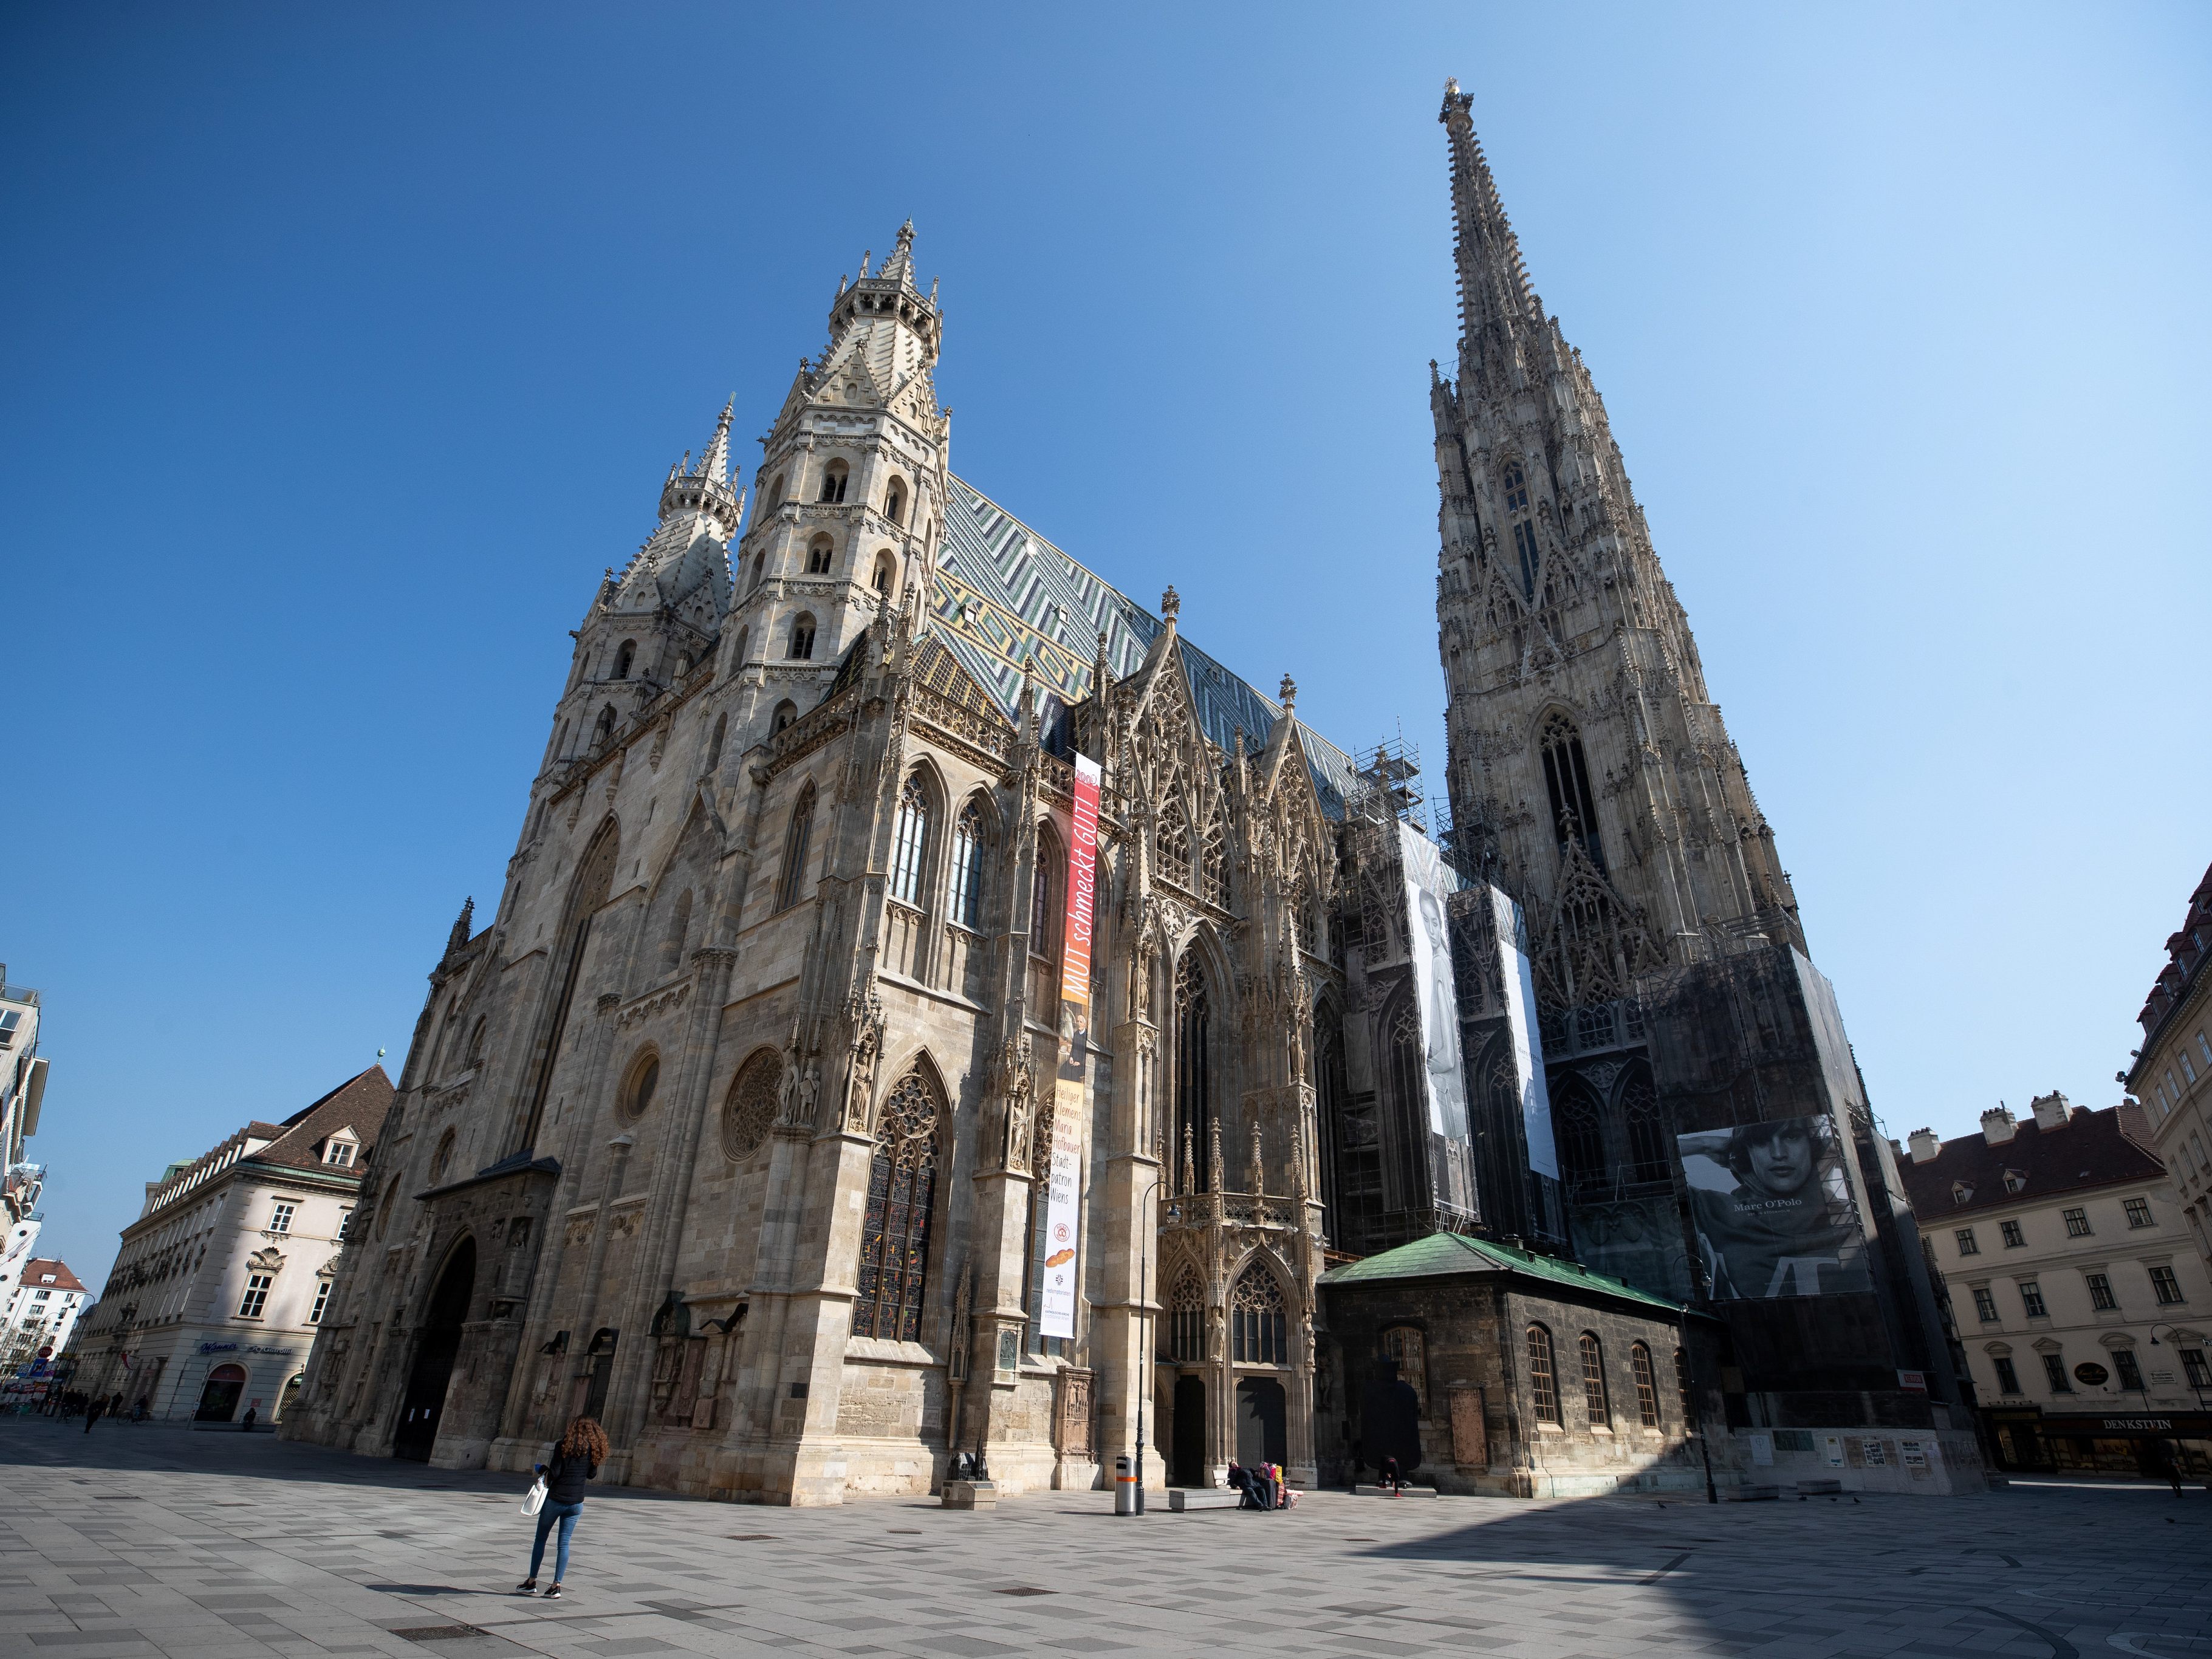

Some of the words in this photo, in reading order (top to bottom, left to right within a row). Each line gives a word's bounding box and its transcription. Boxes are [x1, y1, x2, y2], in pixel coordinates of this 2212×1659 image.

[1073, 796, 1098, 846] GUT!
[1067, 848, 1096, 946] schmeckt
[1063, 942, 1090, 999] MUT
[1056, 1084, 1080, 1105] Heiliger
[1055, 1101, 1081, 1121] Klemens
[1054, 1118, 1072, 1135] Maria
[1053, 1135, 1080, 1155] Hofbauer
[1052, 1152, 1072, 1169] Stadt-
[1051, 1172, 1072, 1188] patron
[1050, 1186, 1069, 1204] Wiens
[1734, 1203, 1763, 1212] Marc
[1765, 1198, 1803, 1209] O'Polo
[2102, 1420, 2172, 1429] DENKSTEIN
